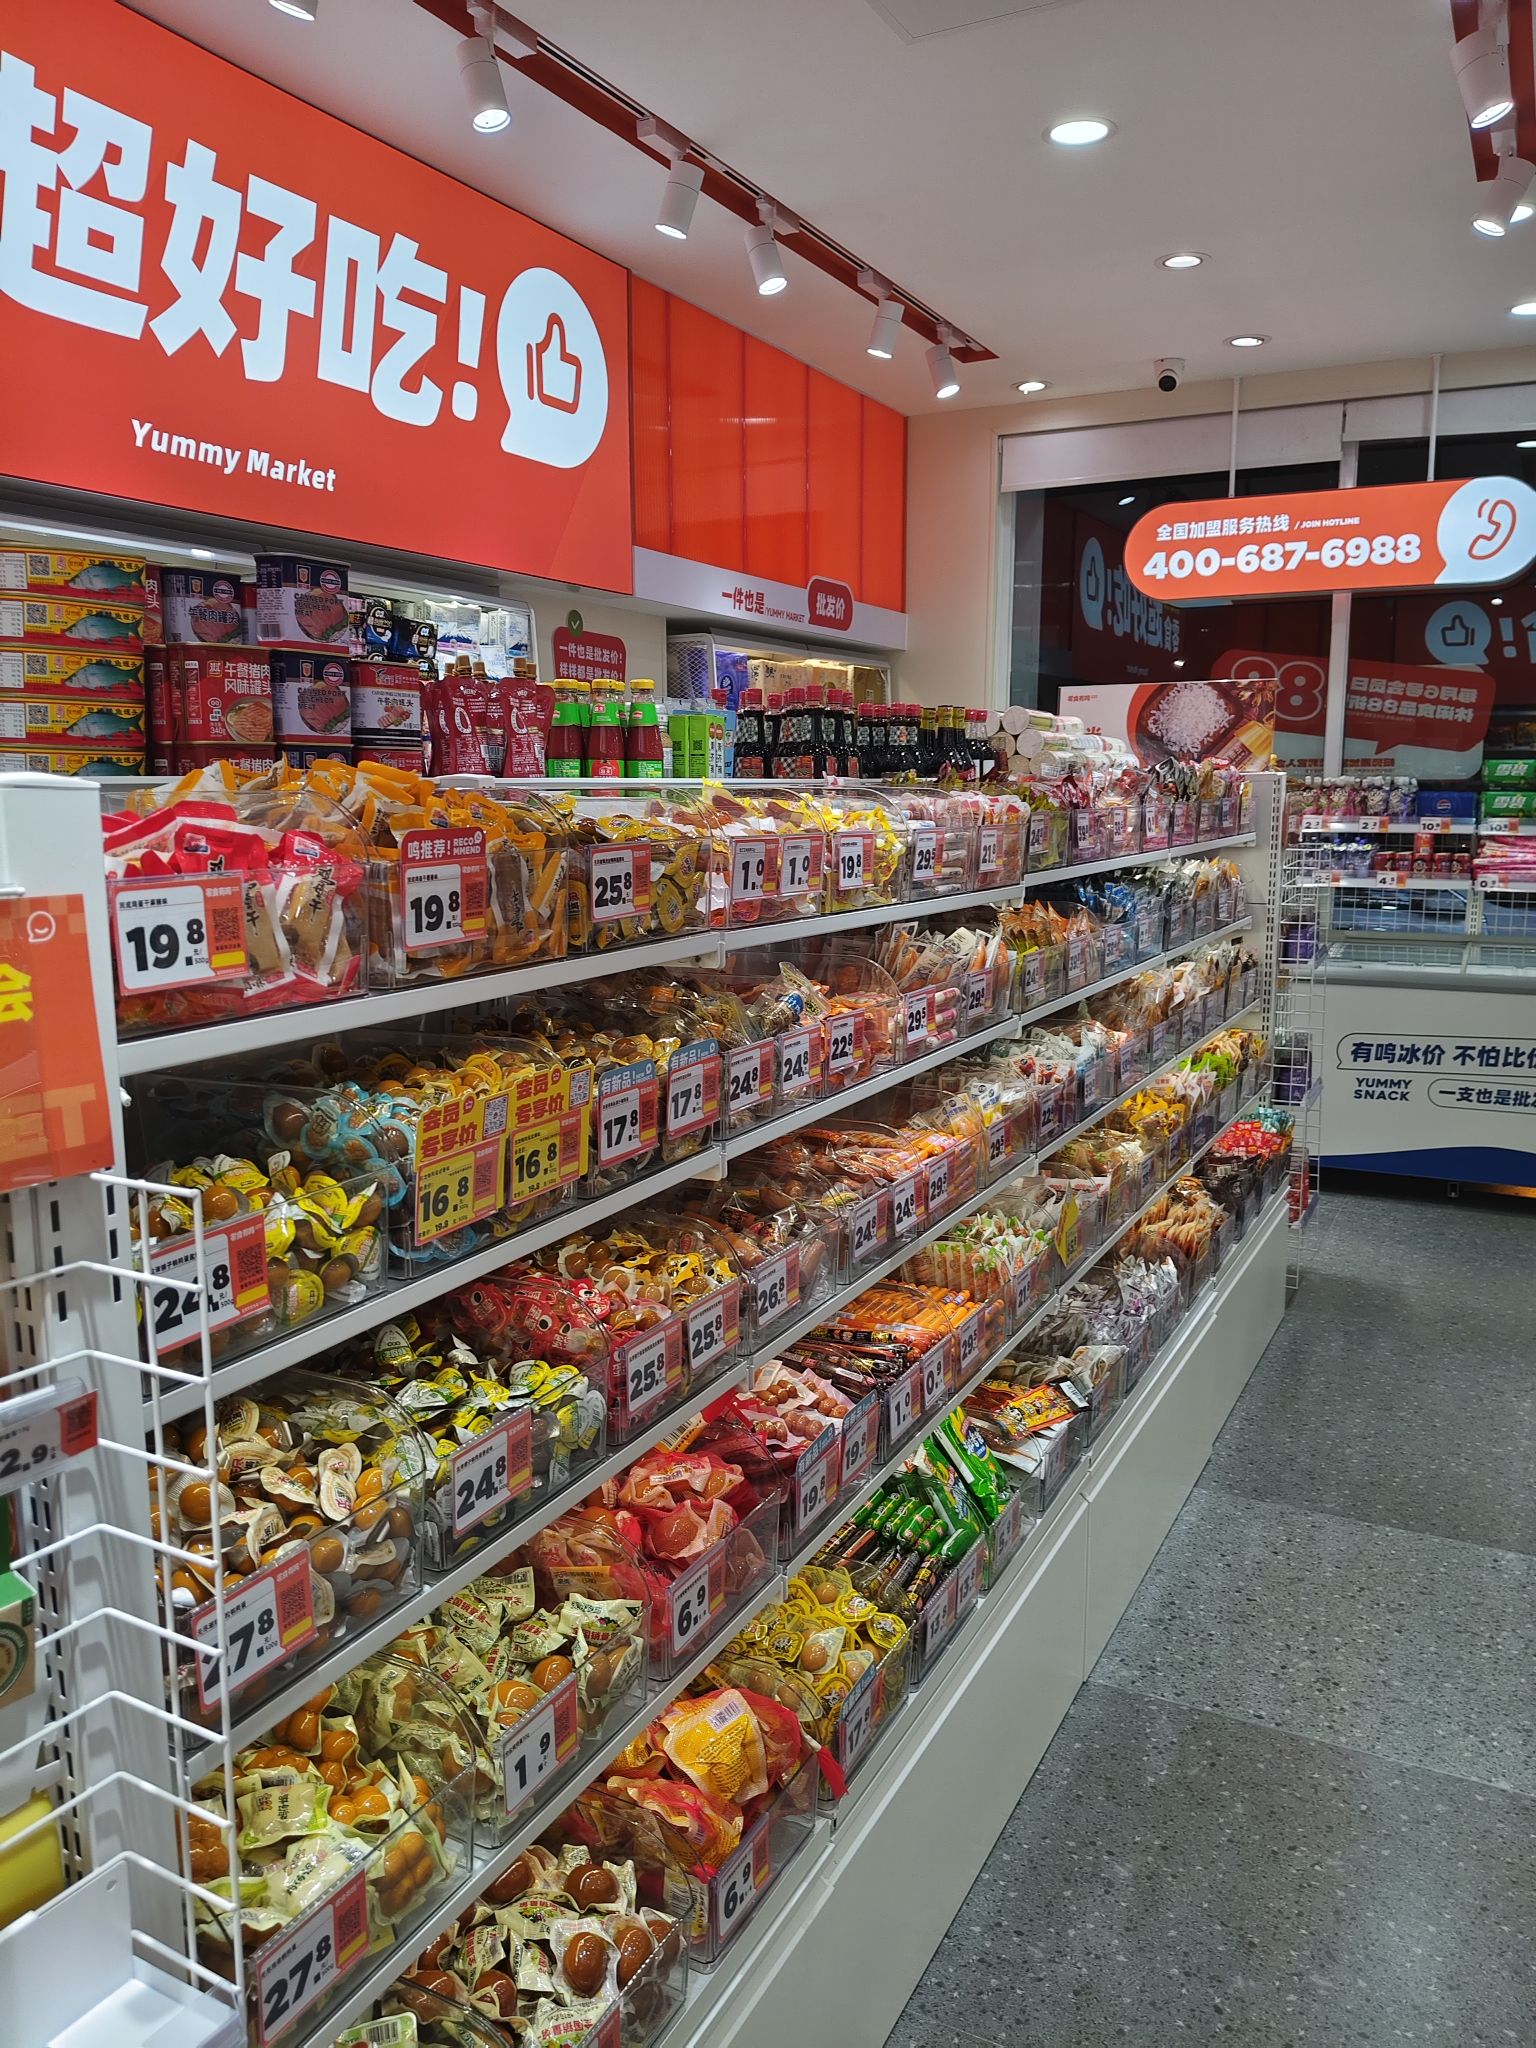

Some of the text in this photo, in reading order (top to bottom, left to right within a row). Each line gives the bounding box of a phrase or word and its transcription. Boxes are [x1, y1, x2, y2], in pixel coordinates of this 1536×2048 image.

[0, 49, 486, 427] 超好吃!
[131, 419, 336, 493] Yummy Market
[1156, 513, 1289, 542] 全国加盟服务热线
[1301, 519, 1321, 529] JOIN
[1322, 516, 1360, 527] HOTLINE
[1142, 533, 1421, 580] 400-687-6988
[188, 607, 239, 625] 午餐肉罐头
[722, 586, 765, 615] 一件也是
[785, 611, 805, 623] MARKET
[816, 592, 846, 621] 批发价
[560, 642, 623, 664] 一件也是批发价!
[224, 661, 271, 680] 午餐猪肉
[224, 678, 272, 695] 风味罐头
[407, 839, 452, 860] 鸣推荐!
[453, 838, 474, 847] RECO
[453, 845, 481, 856] MMEND
[742, 859, 765, 890] 1.0
[789, 856, 810, 885] 1.0
[841, 854, 862, 879] 19.8
[594, 872, 632, 908] 25.8
[410, 890, 460, 934] 19.8
[126, 918, 205, 972] 19.8
[908, 1007, 926, 1033] 29.5
[671, 1049, 701, 1070] 有新品!
[831, 1033, 853, 1061] 22.8
[1351, 1042, 1446, 1066] 有鸣冰价
[601, 1071, 636, 1094] 有新品!
[784, 1050, 809, 1083] 24.8
[1356, 1077, 1412, 1089] YUMMY
[516, 1073, 549, 1101] 会员
[729, 1066, 758, 1102] 24.8
[1353, 1089, 1410, 1101] SNACK
[423, 1101, 461, 1133] 会员
[515, 1092, 565, 1125] 专享价
[671, 1083, 702, 1120] 17.8
[420, 1121, 478, 1157] 专享价
[604, 1109, 638, 1149] 17.8
[515, 1142, 557, 1183] 16.8
[420, 1176, 469, 1222] 16.8
[758, 1276, 785, 1318] 26.8
[691, 1314, 723, 1360] 25.8
[630, 1353, 665, 1402] 25.8
[926, 1360, 942, 1396] 0.9
[894, 1391, 910, 1426] 1.0
[457, 1455, 507, 1519] 24.8
[677, 1582, 706, 1637] 6.9
[515, 1731, 551, 1789] 1.9
[724, 1861, 751, 1919] 6.9
[264, 1934, 331, 2030] 27.8
